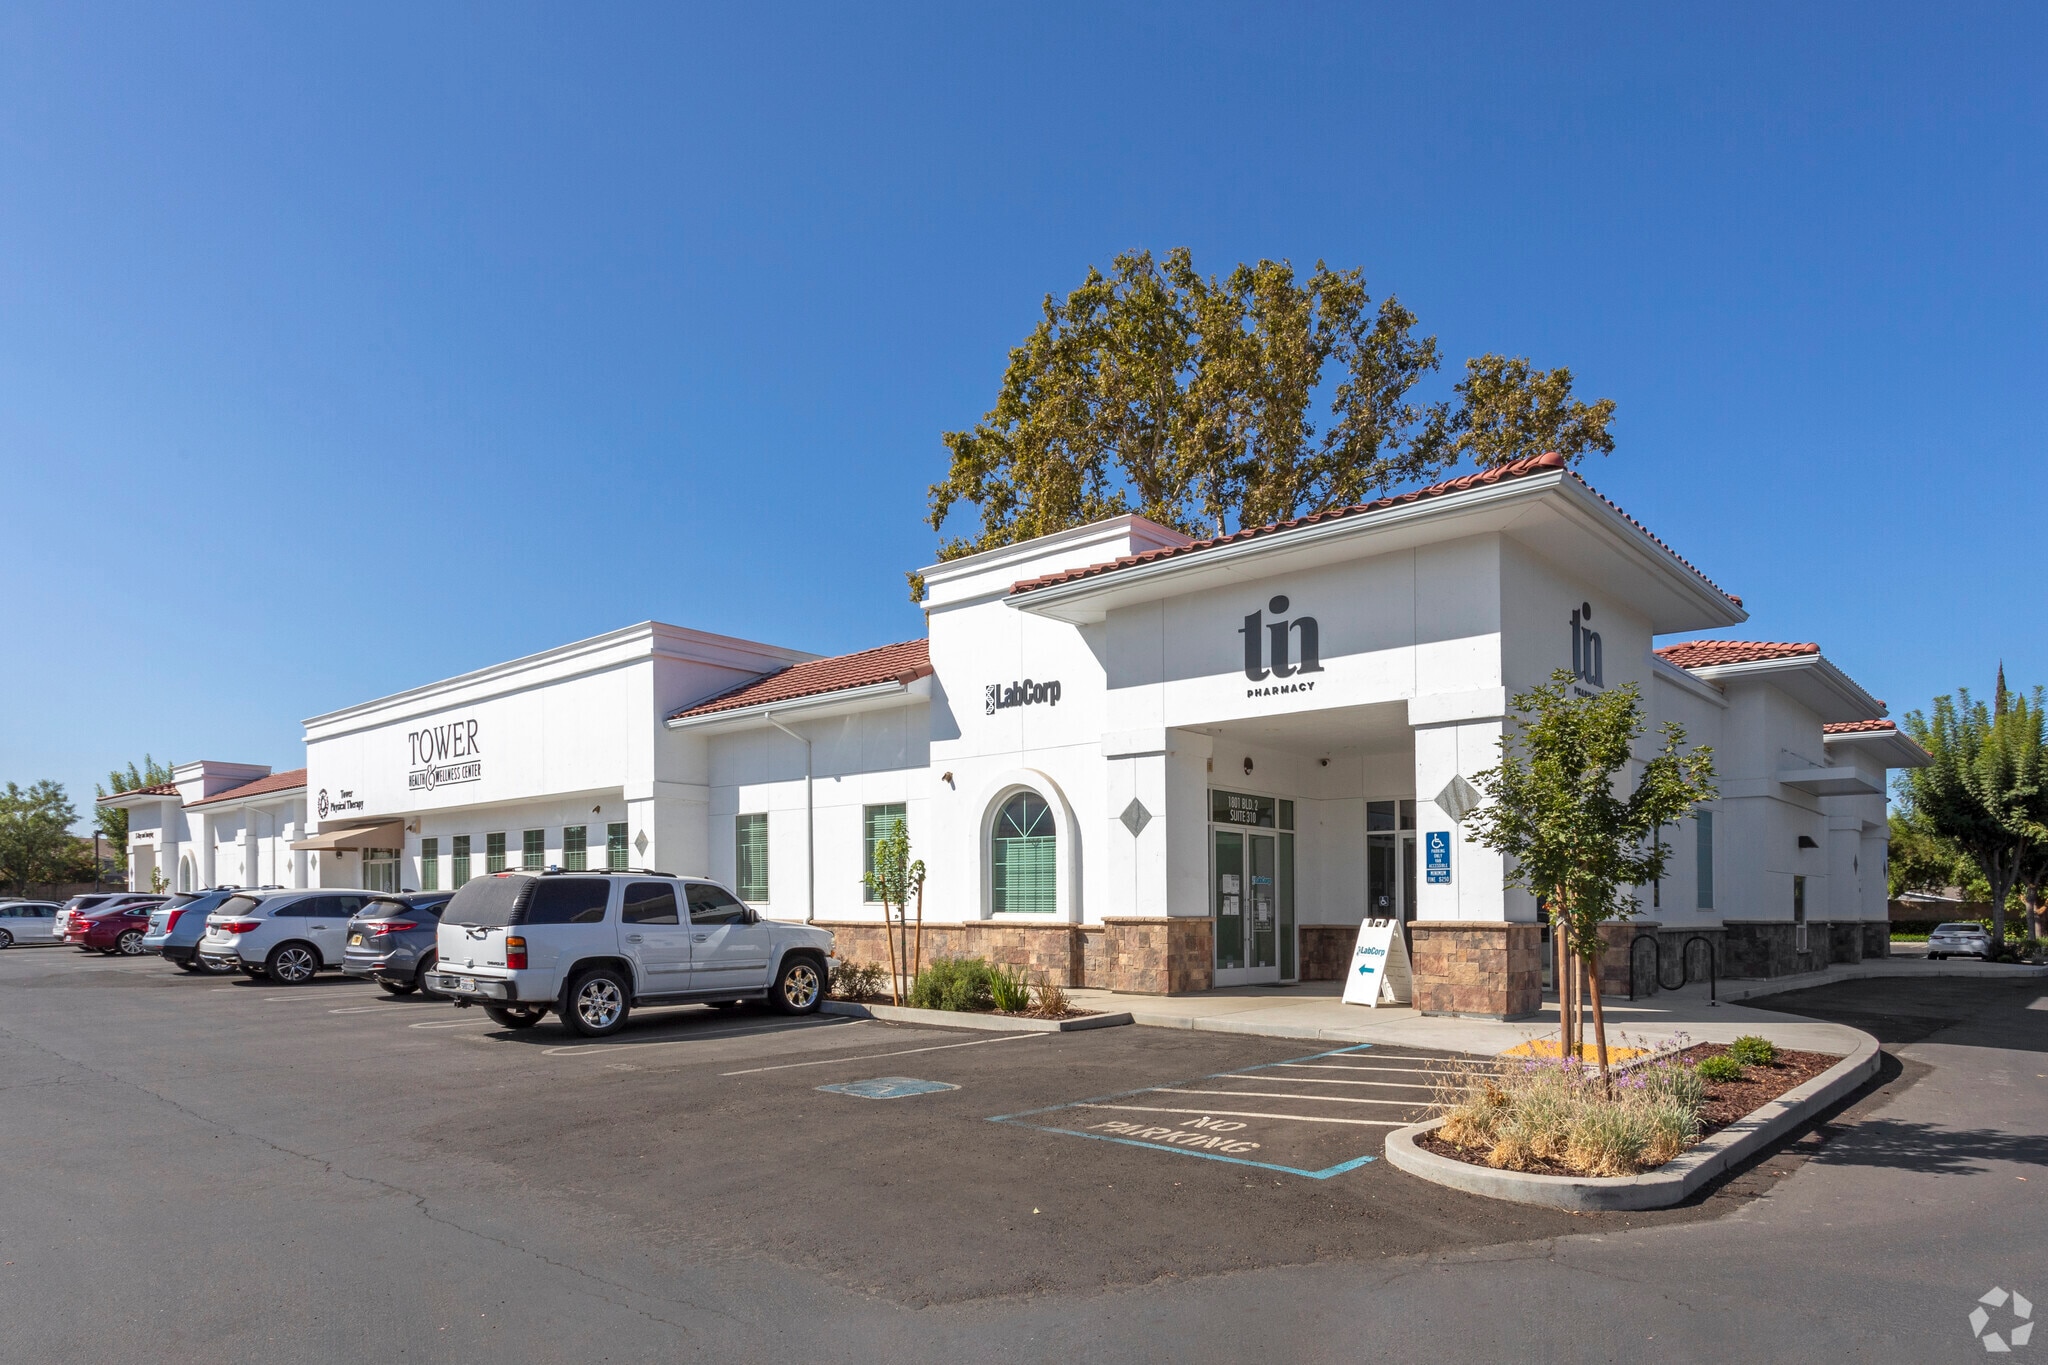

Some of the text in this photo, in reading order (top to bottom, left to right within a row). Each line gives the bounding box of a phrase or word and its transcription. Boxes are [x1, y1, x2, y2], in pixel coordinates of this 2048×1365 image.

[1238, 595, 1325, 682] tin
[1570, 602, 1604, 688] tin
[996, 679, 1061, 709] LabCorp
[1247, 682, 1315, 698] PHARMACY
[408, 719, 480, 765] TOWER
[409, 763, 481, 791] HEALTH & WELLNESS CENTER
[340, 790, 353, 799] Tower
[1228, 795, 1259, 811] 1801 BLD. 2
[1230, 809, 1245, 822] SUITE
[1361, 946, 1386, 957] LabCorp
[1179, 1117, 1247, 1132] NO
[1086, 1121, 1261, 1153] PARKING
